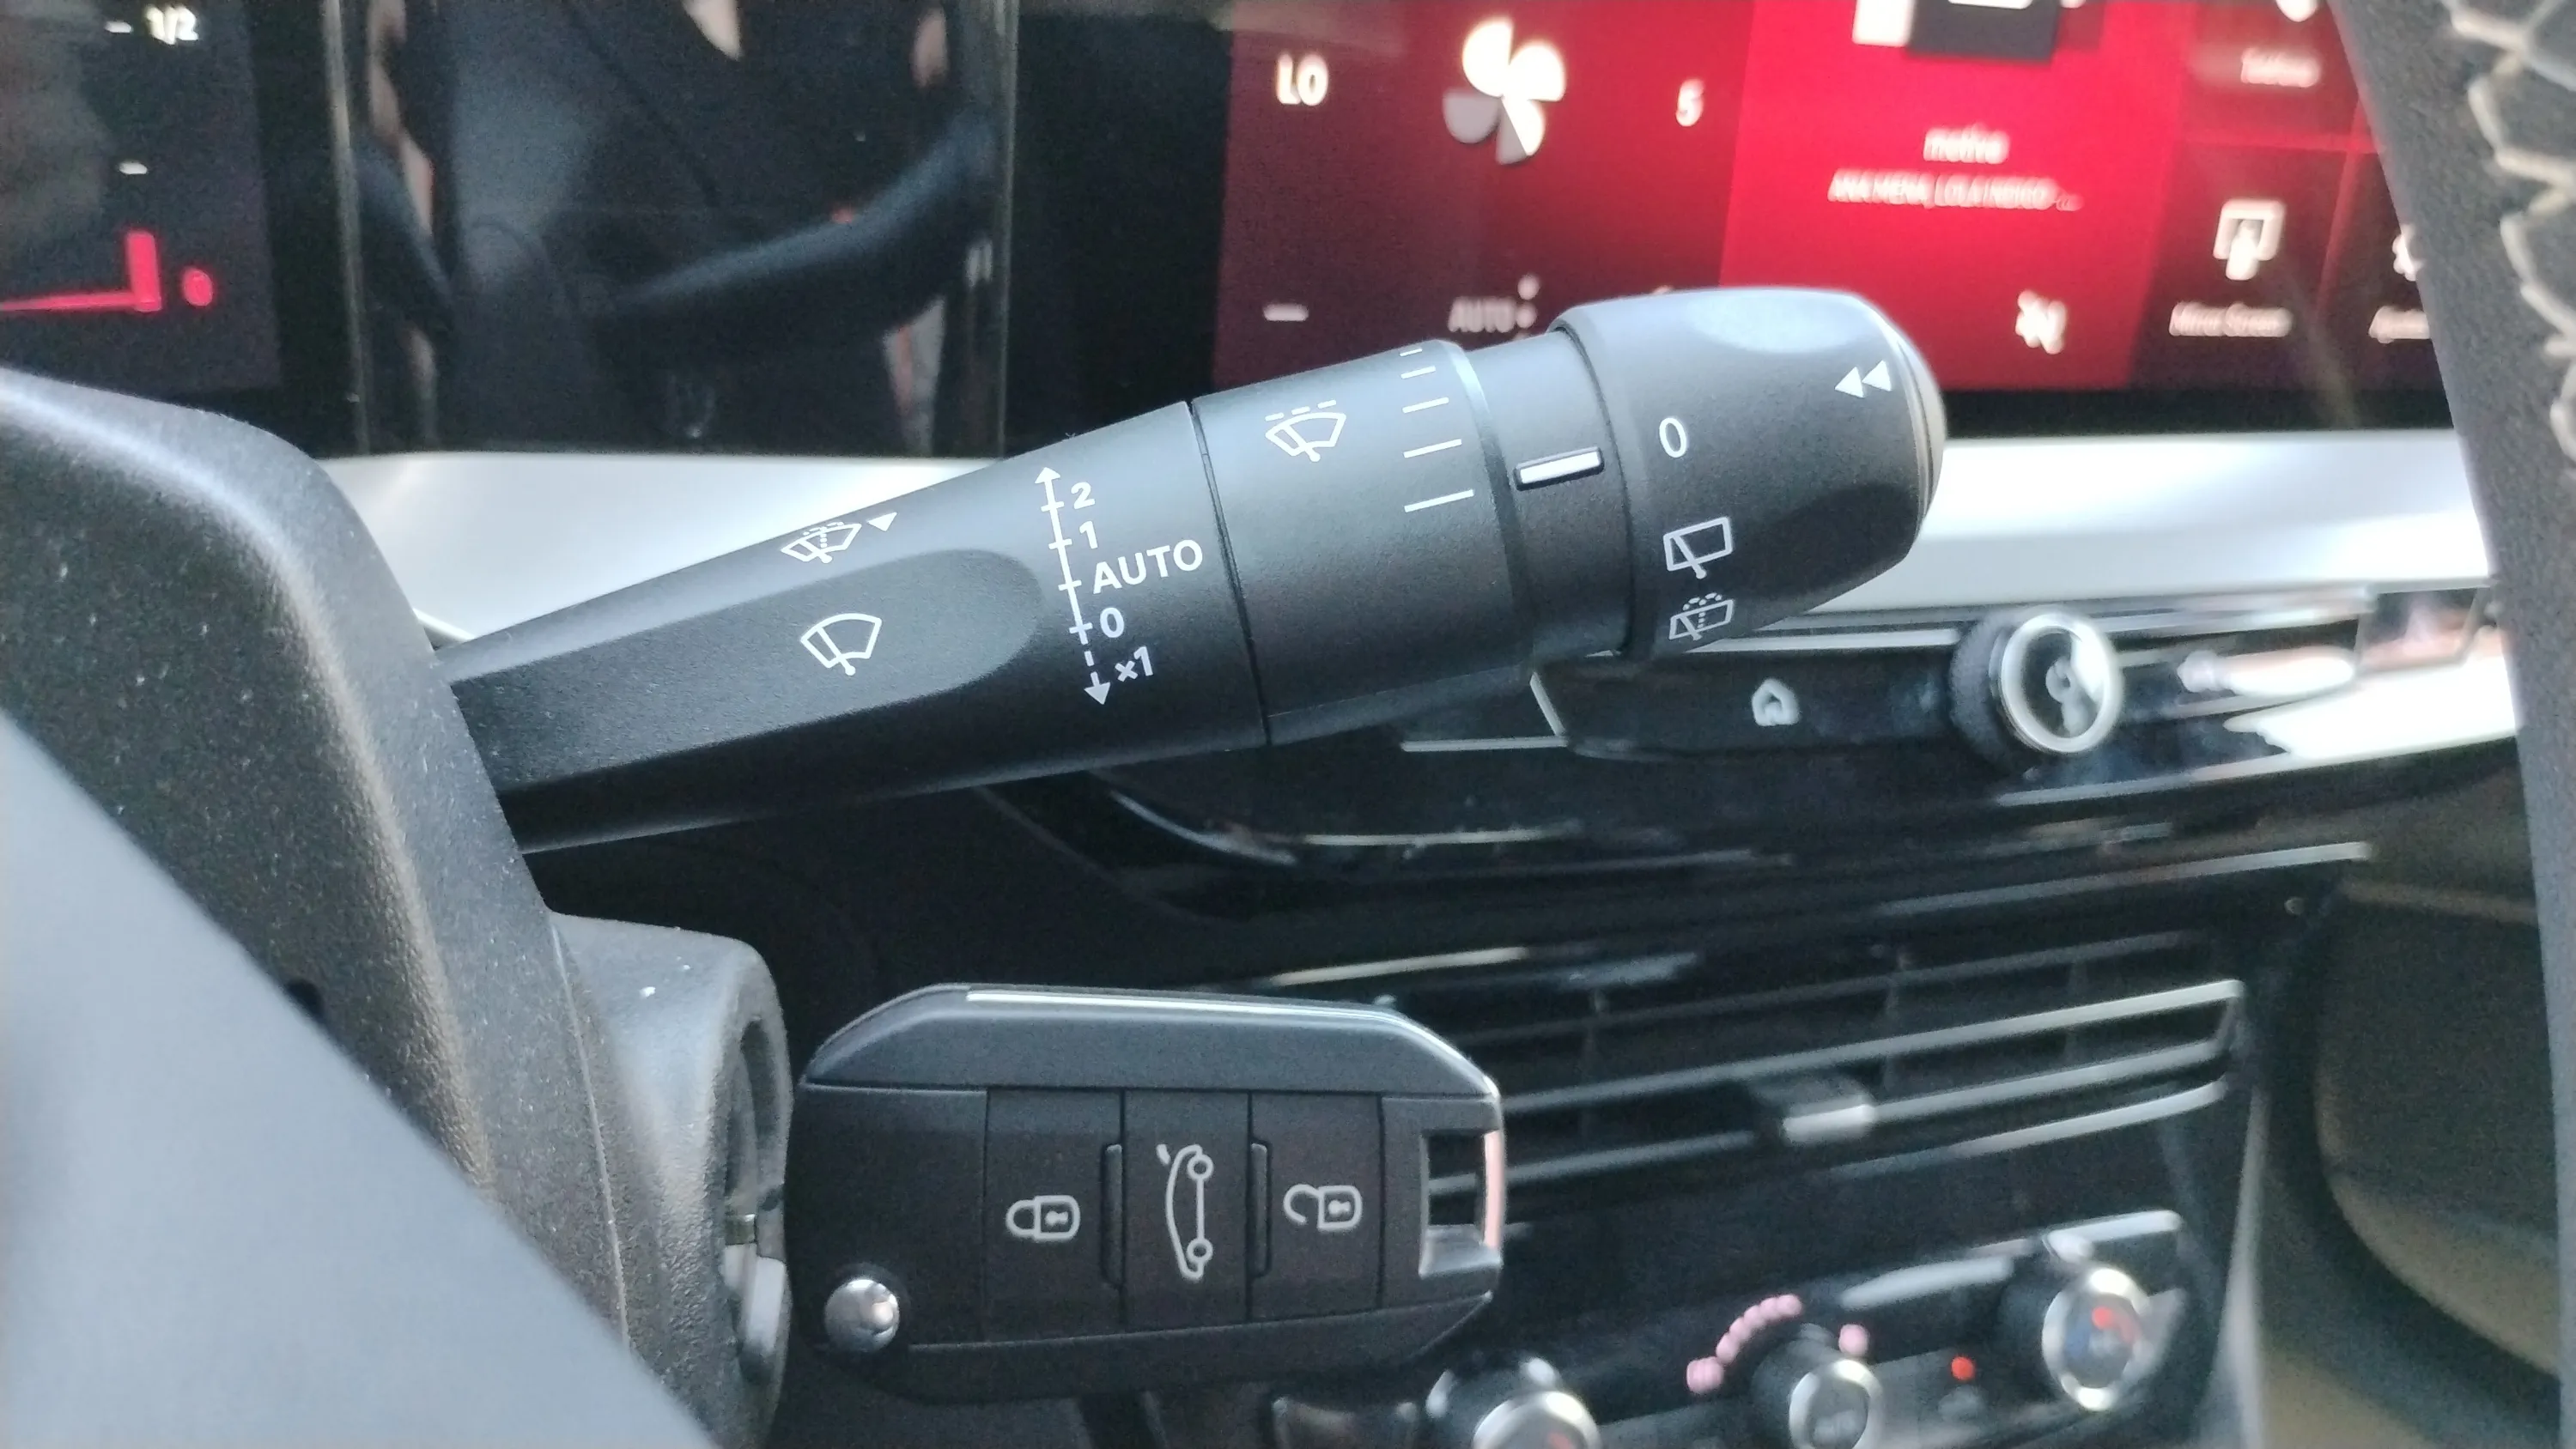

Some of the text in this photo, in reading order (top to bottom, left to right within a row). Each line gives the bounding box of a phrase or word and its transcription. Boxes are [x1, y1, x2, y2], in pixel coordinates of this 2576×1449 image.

[1276, 54, 1330, 106] LO
[1659, 417, 1687, 458] 0
[1071, 482, 1096, 510] 2
[1078, 520, 1098, 549] 1
[1093, 539, 1204, 594] AUTO
[1099, 607, 1125, 638] 0
